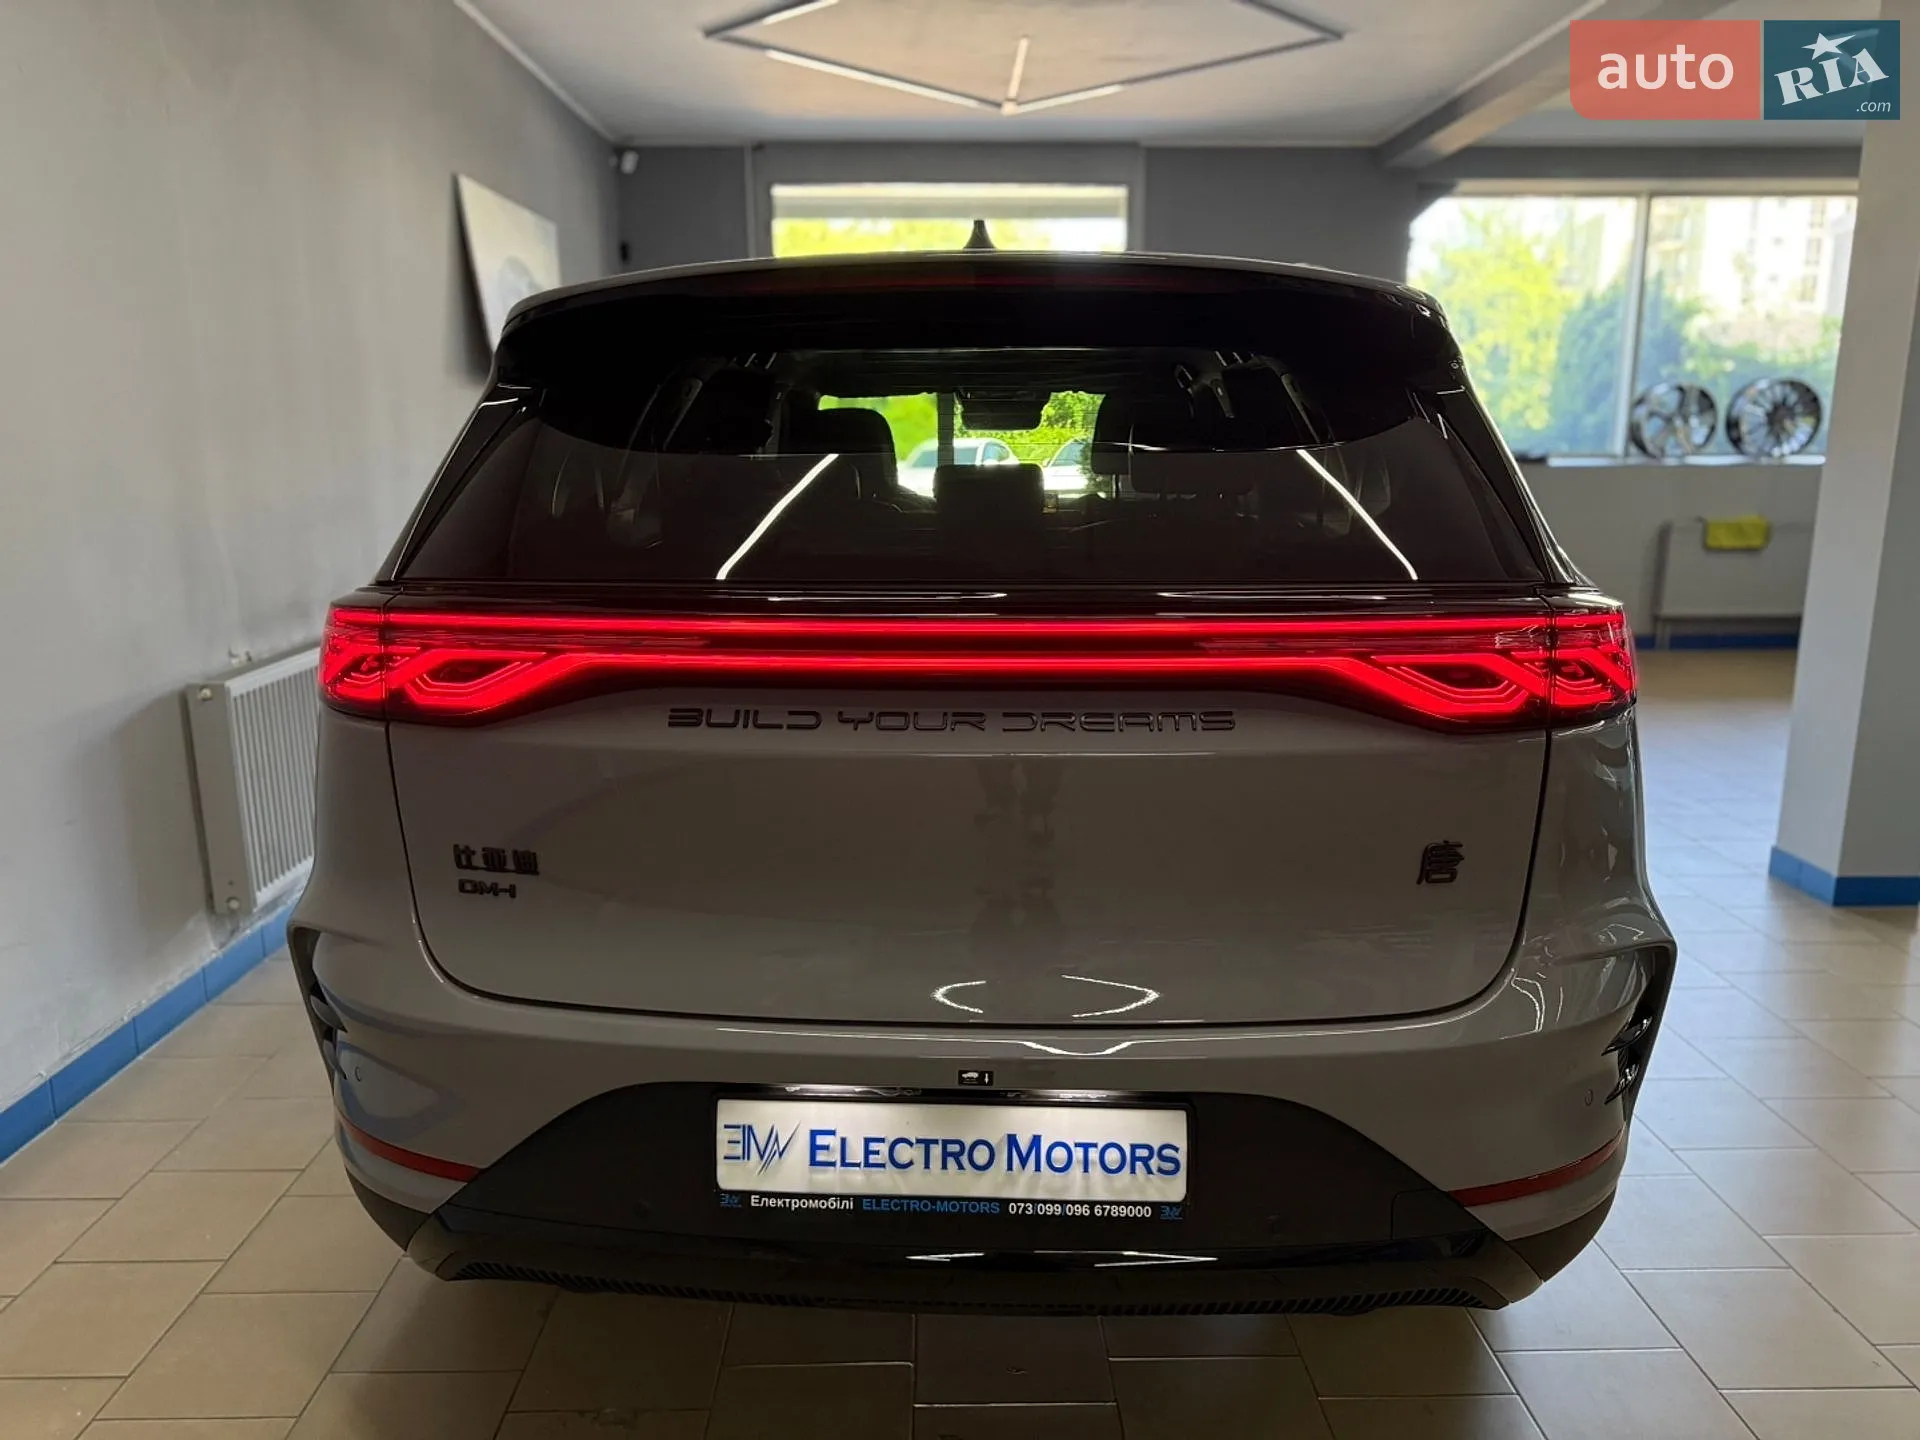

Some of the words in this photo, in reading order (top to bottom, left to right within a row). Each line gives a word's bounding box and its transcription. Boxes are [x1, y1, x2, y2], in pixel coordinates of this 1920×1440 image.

[668, 708, 823, 730] BUILD
[838, 710, 986, 731] YOUR
[1001, 711, 1235, 732] DREAMS
[1416, 840, 1465, 885] 唐
[750, 1194, 854, 1212] Електромобілі
[862, 1198, 1000, 1214] ELECTRO-MOTORS
[1094, 1204, 1152, 1218] 6789000
